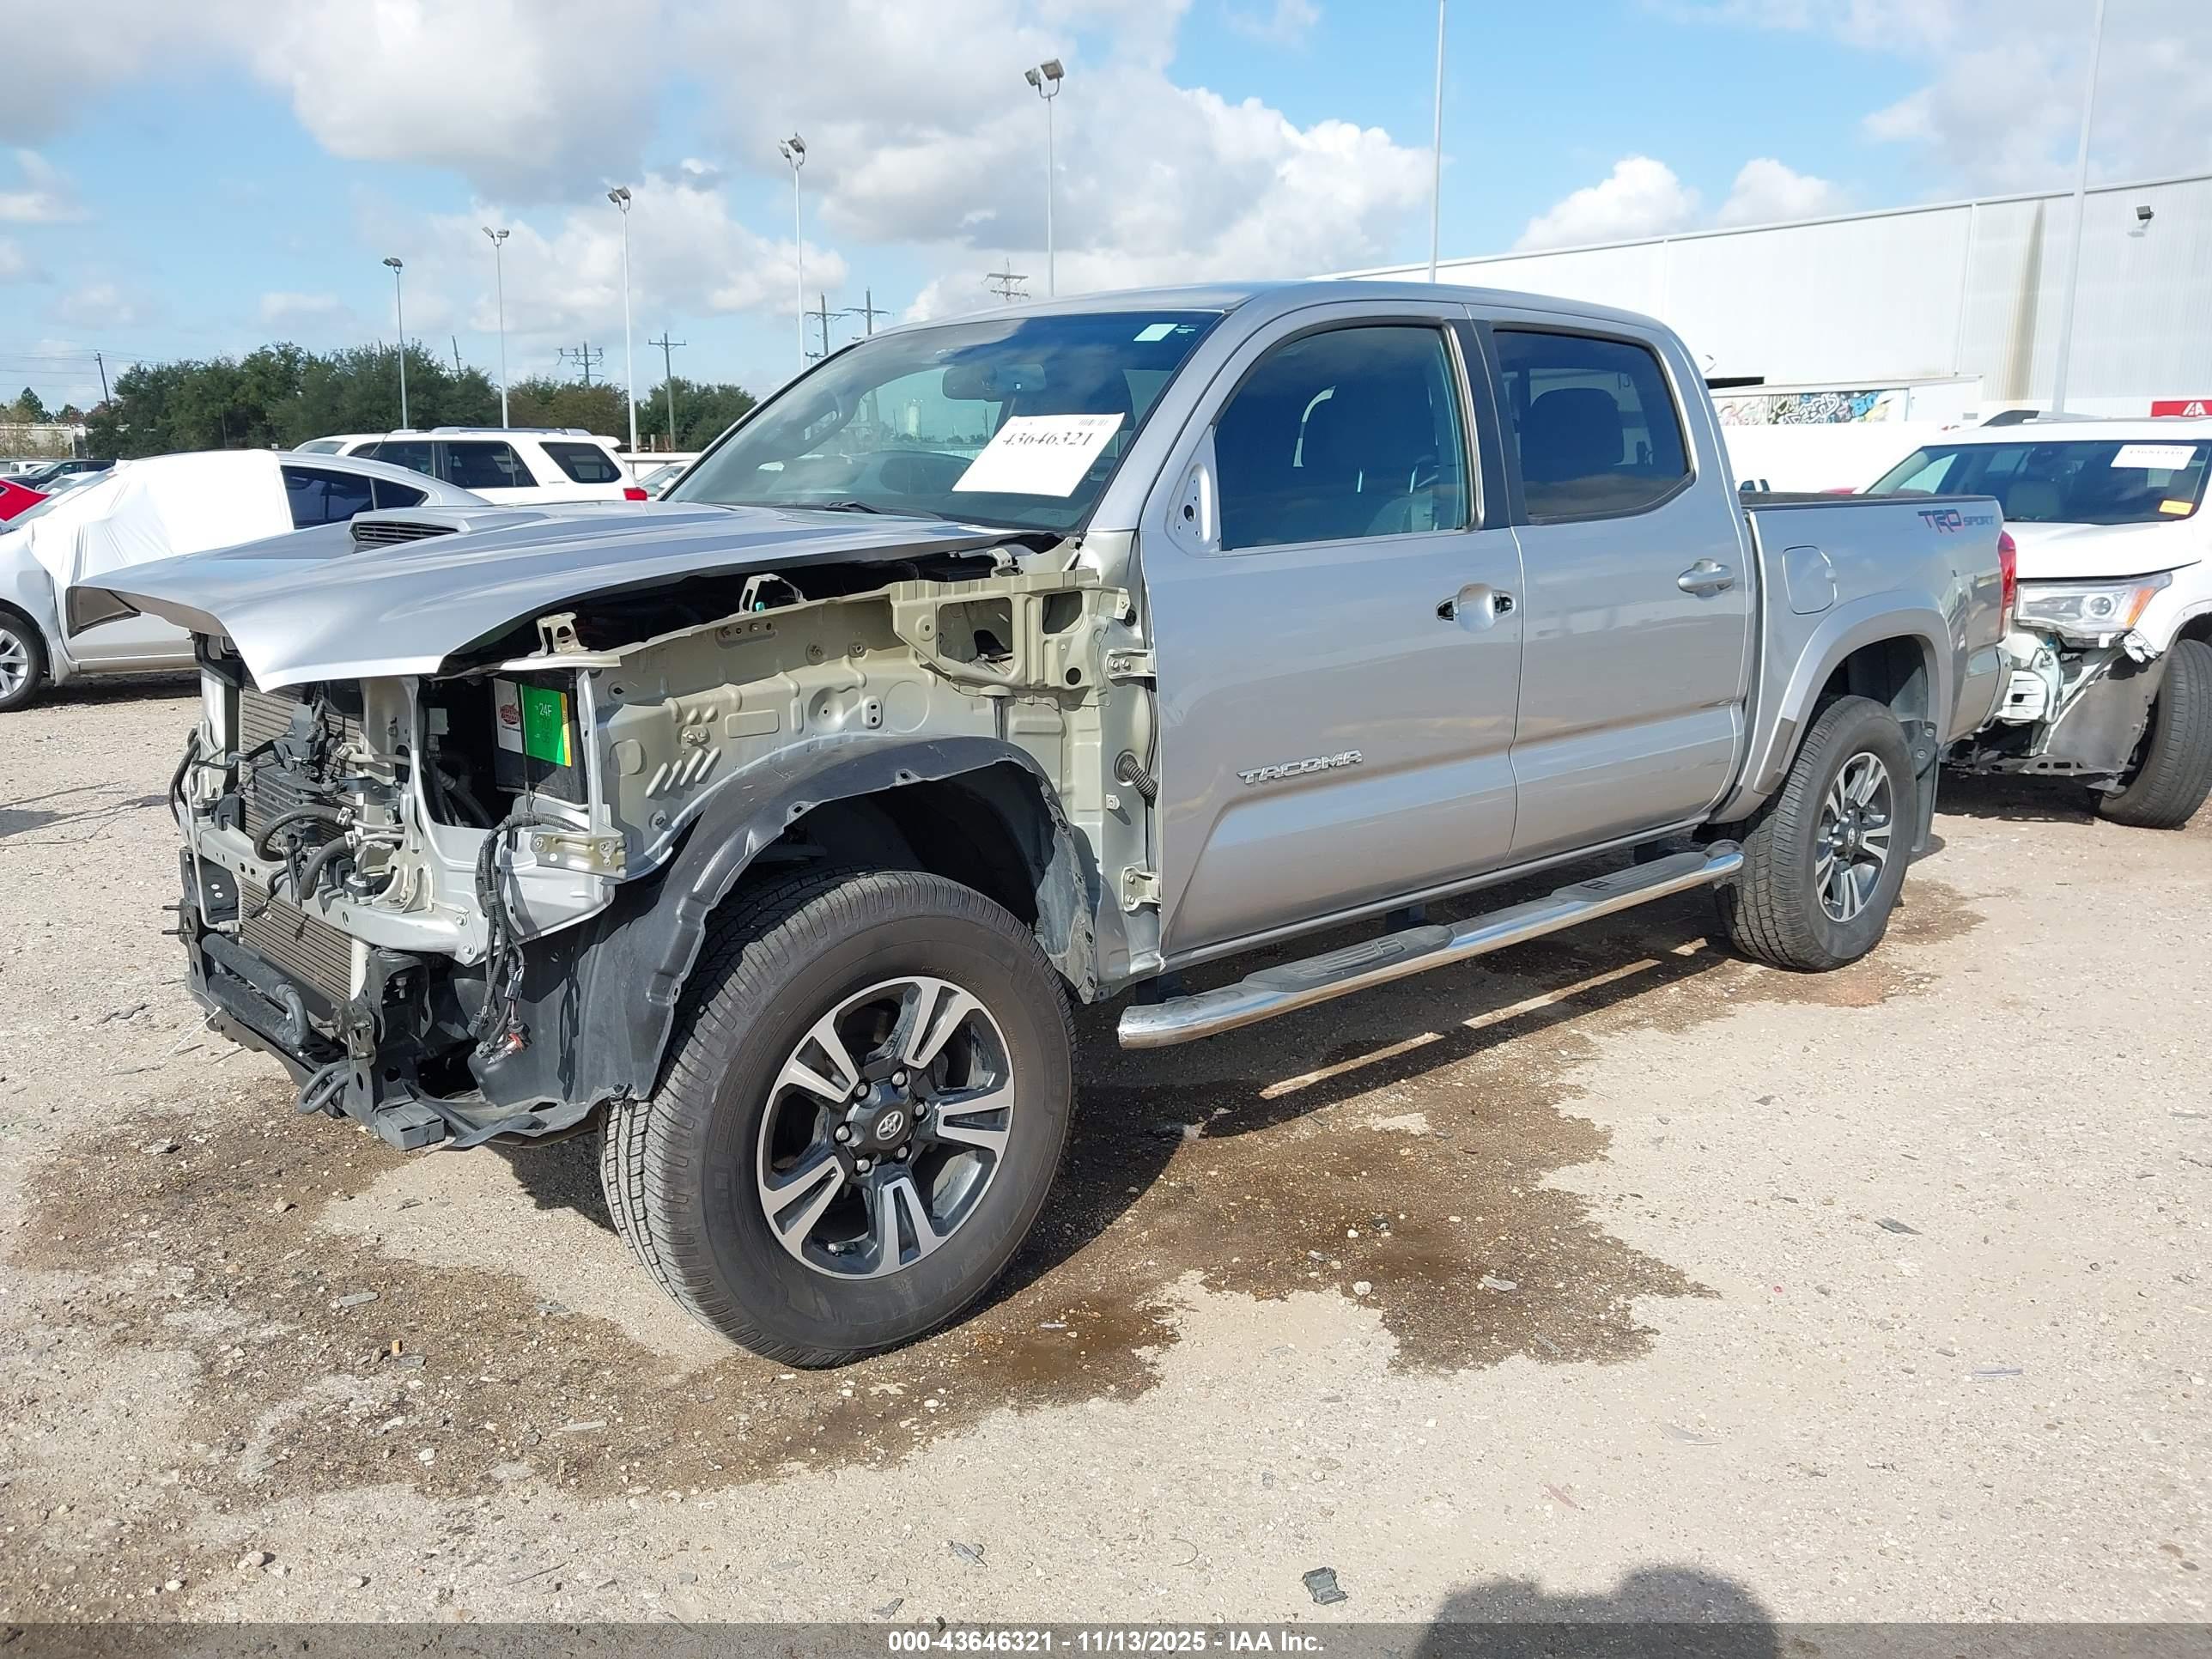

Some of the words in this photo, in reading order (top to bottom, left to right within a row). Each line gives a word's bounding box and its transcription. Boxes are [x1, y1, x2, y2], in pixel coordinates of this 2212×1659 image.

[1002, 431, 1095, 447] 43646321
[1917, 508, 1963, 533] TRD
[1963, 515, 1995, 526] SPORT
[538, 702, 553, 718] 24F
[1237, 750, 1363, 784] TACOMA
